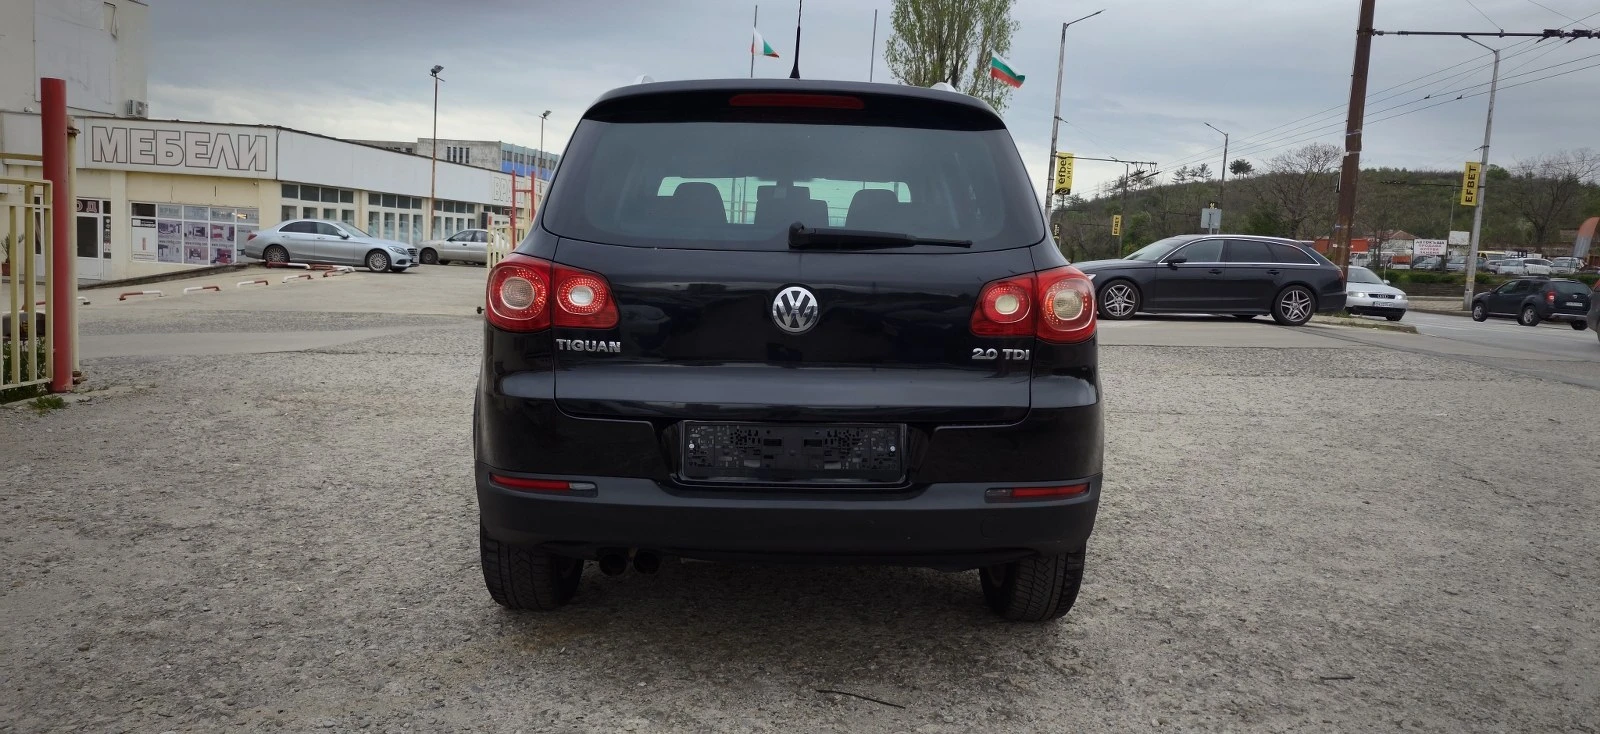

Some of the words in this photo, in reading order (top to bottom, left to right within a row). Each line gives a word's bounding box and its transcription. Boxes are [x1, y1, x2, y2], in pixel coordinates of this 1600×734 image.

[92, 126, 267, 172] МЕБЕЛИ
[1465, 165, 1477, 202] EFBET
[556, 338, 621, 353] TIGUAN
[1002, 349, 1030, 361] TDI
